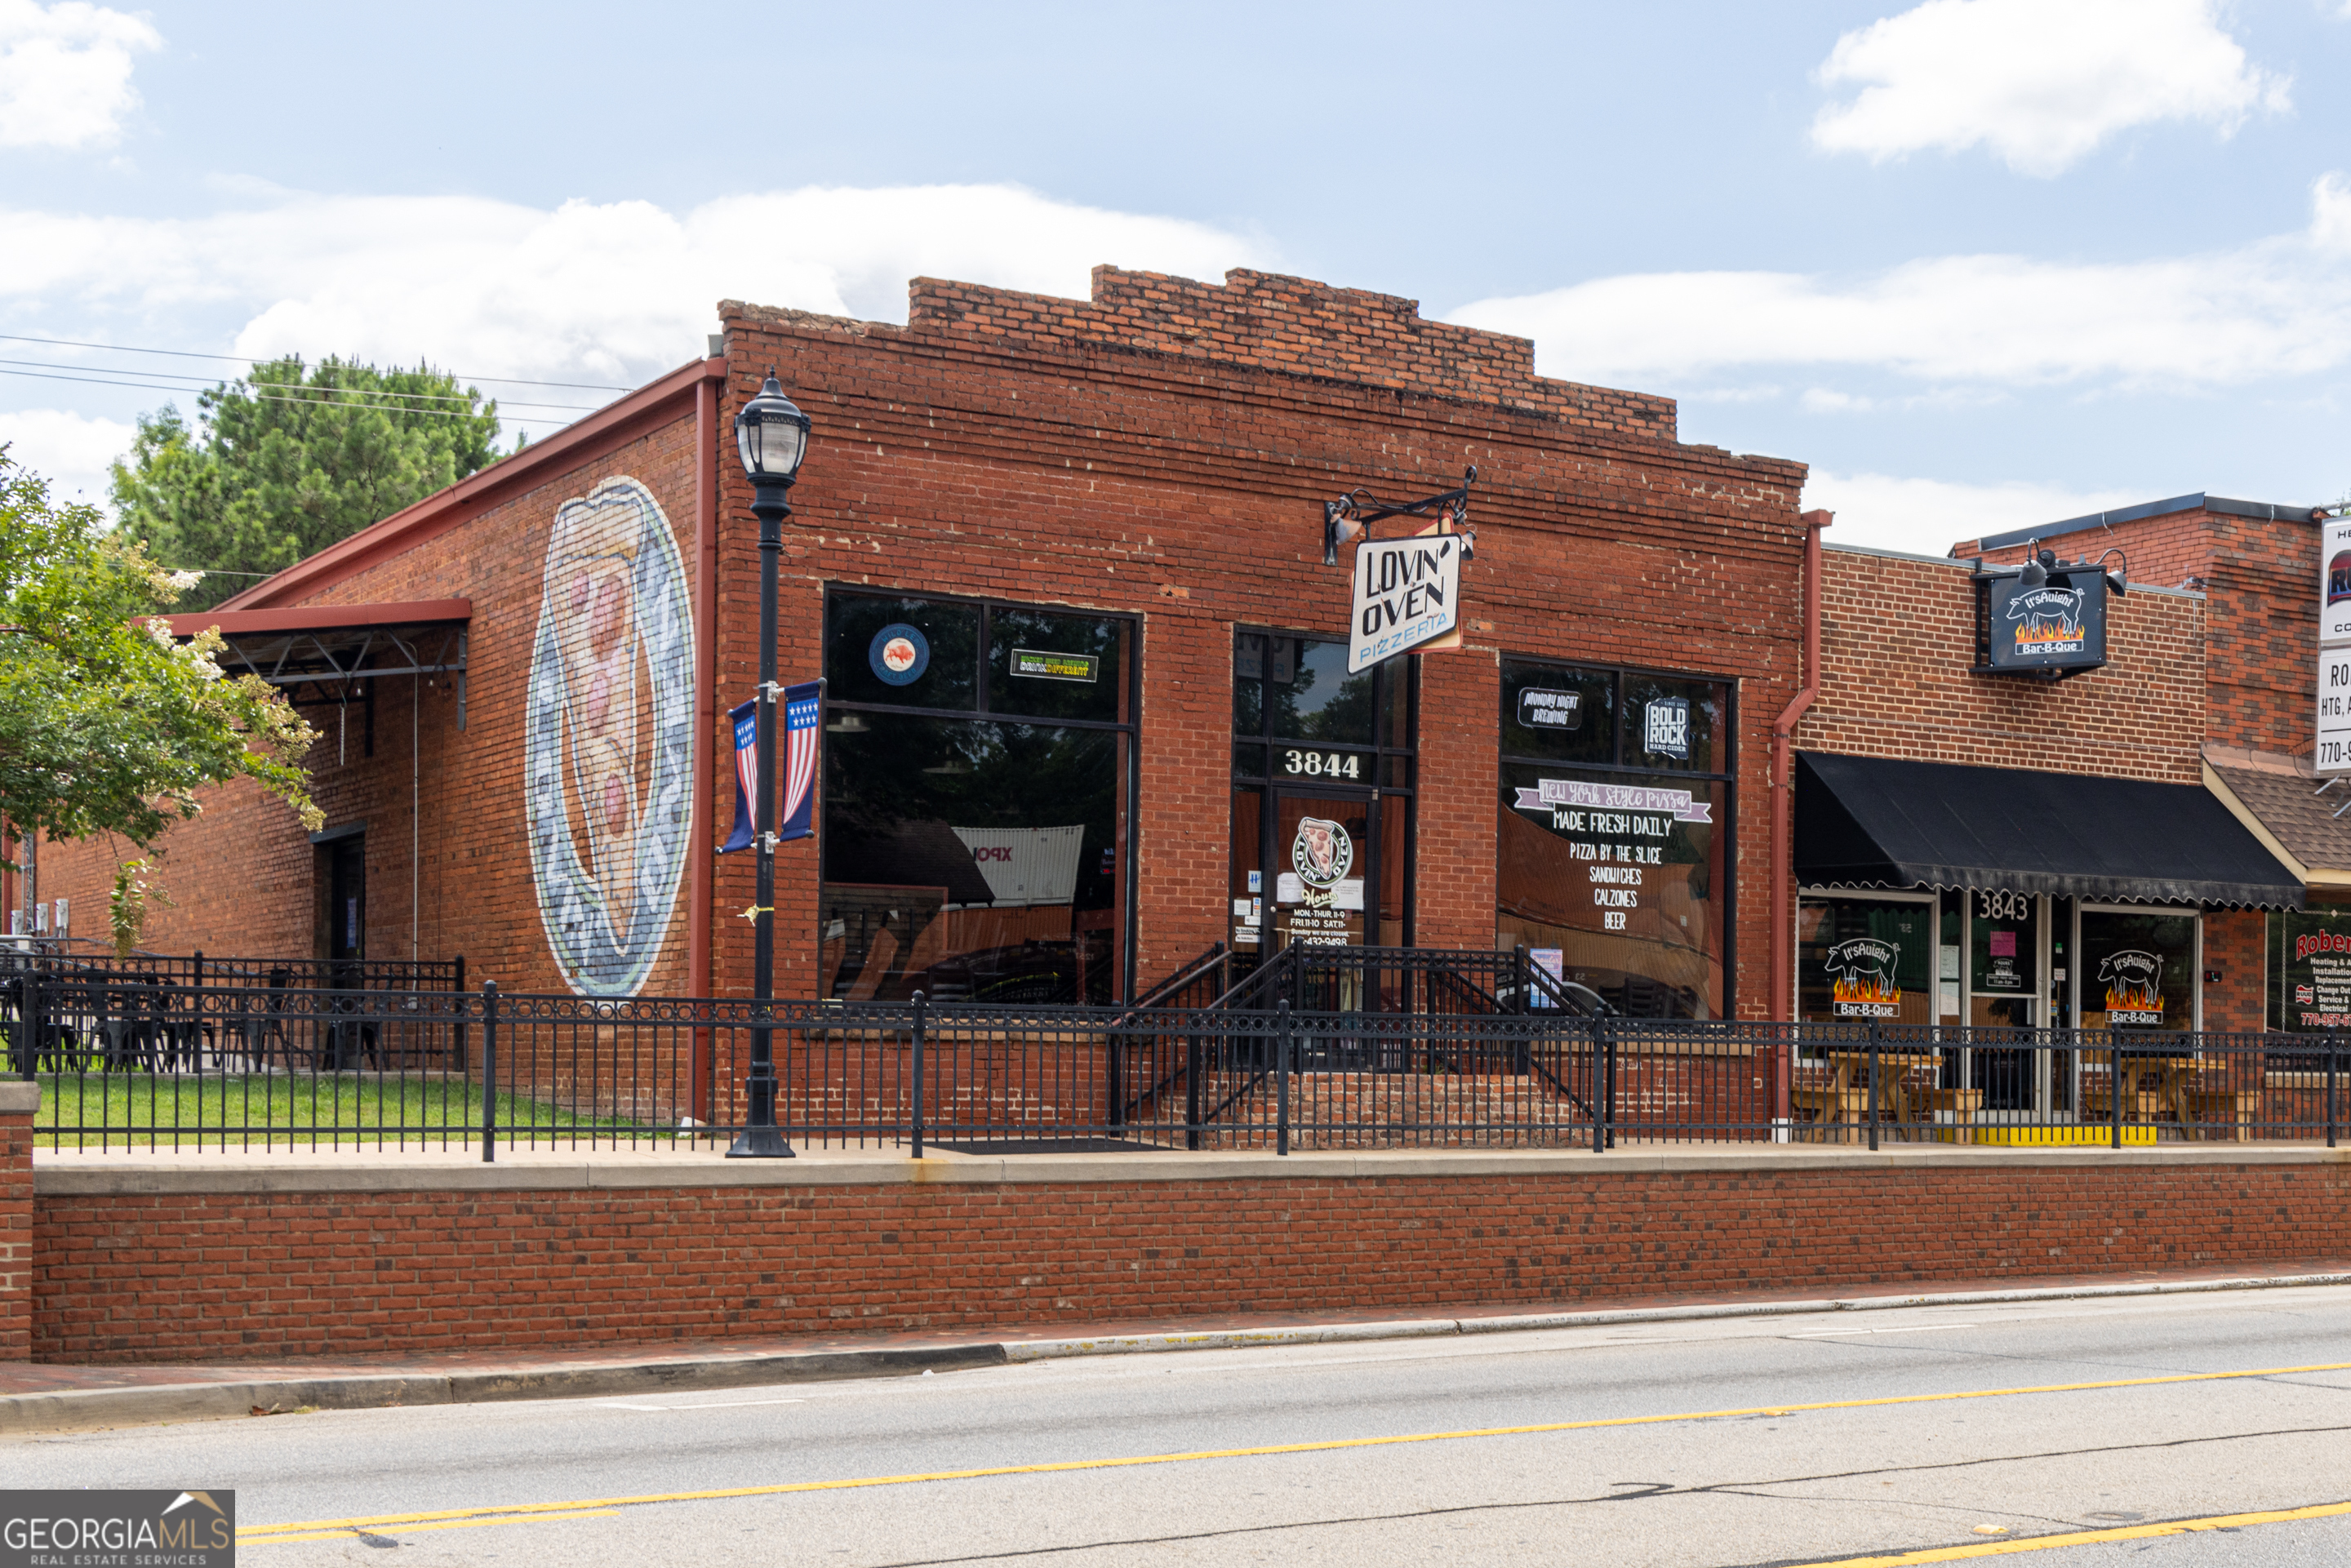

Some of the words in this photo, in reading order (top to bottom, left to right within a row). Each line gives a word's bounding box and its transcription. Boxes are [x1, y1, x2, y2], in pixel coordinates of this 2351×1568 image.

[1367, 540, 1451, 598] LOVIN'
[2331, 567, 2351, 593] R
[1362, 576, 1445, 637] OVEN
[881, 629, 902, 642] WILD
[1359, 612, 1447, 664] PIZZERIA
[2022, 642, 2078, 655] Bar-B-Que
[2331, 663, 2351, 687] RO
[1524, 691, 1557, 708] MONDAY
[1557, 695, 1579, 709] NIGHT
[2322, 696, 2344, 717] HTG,
[1532, 708, 1568, 725] BREWING
[1650, 705, 1687, 726] BOLD
[1650, 725, 1687, 746] ROCK
[1667, 744, 1687, 753] CIDER
[1285, 749, 1359, 779] 3844
[1553, 811, 1585, 832] MADE
[1590, 812, 1630, 833] FRESH
[1633, 816, 1672, 837] DAILY
[1296, 841, 1321, 882] LOVIN'
[1332, 836, 1348, 877] OVEN
[1570, 843, 1596, 860] PIZZA
[1600, 846, 1611, 861] BY
[1616, 846, 1631, 863] THE
[1636, 846, 1662, 865] SLICE
[1589, 866, 1642, 886] SANDWICHES
[1301, 888, 1339, 908] Hours
[1594, 888, 1638, 908] CALZONES
[1980, 895, 2028, 921] 3843
[1604, 912, 1626, 931] BEER
[1291, 928, 1311, 936] Sunday
[1291, 936, 1347, 946] -432-9498
[2310, 957, 2337, 967] Heating
[2317, 985, 2339, 995] Change
[2340, 986, 2350, 994] Out
[2318, 995, 2342, 1003] Service
[1840, 1003, 1893, 1016] Bar-B-Que
[2112, 1011, 2158, 1023] Bar-B-Que
[2319, 1004, 2348, 1012] Electrical
